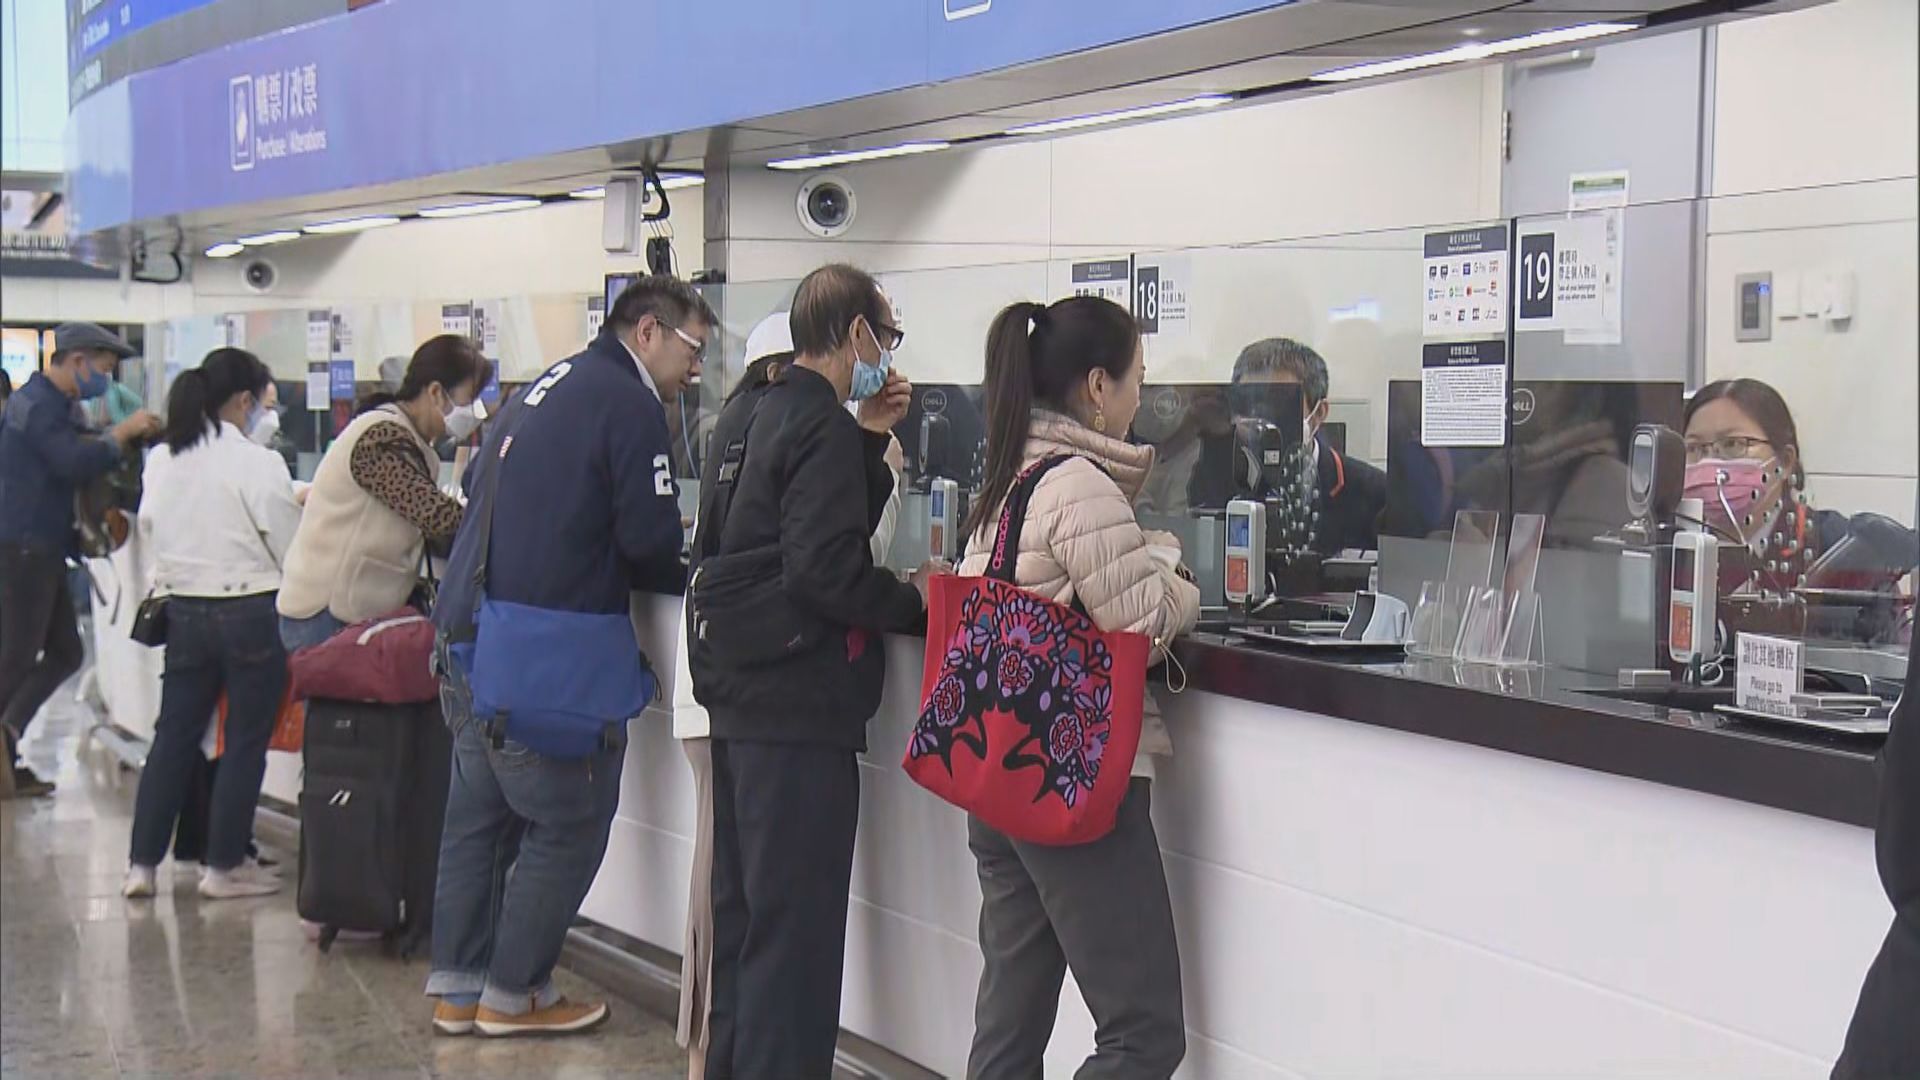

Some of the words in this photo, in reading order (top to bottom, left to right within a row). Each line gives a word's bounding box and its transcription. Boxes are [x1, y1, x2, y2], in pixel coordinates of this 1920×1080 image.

[1524, 251, 1551, 302] 19
[1139, 280, 1157, 321] 18
[523, 361, 573, 407] 2
[653, 453, 674, 496] 2
